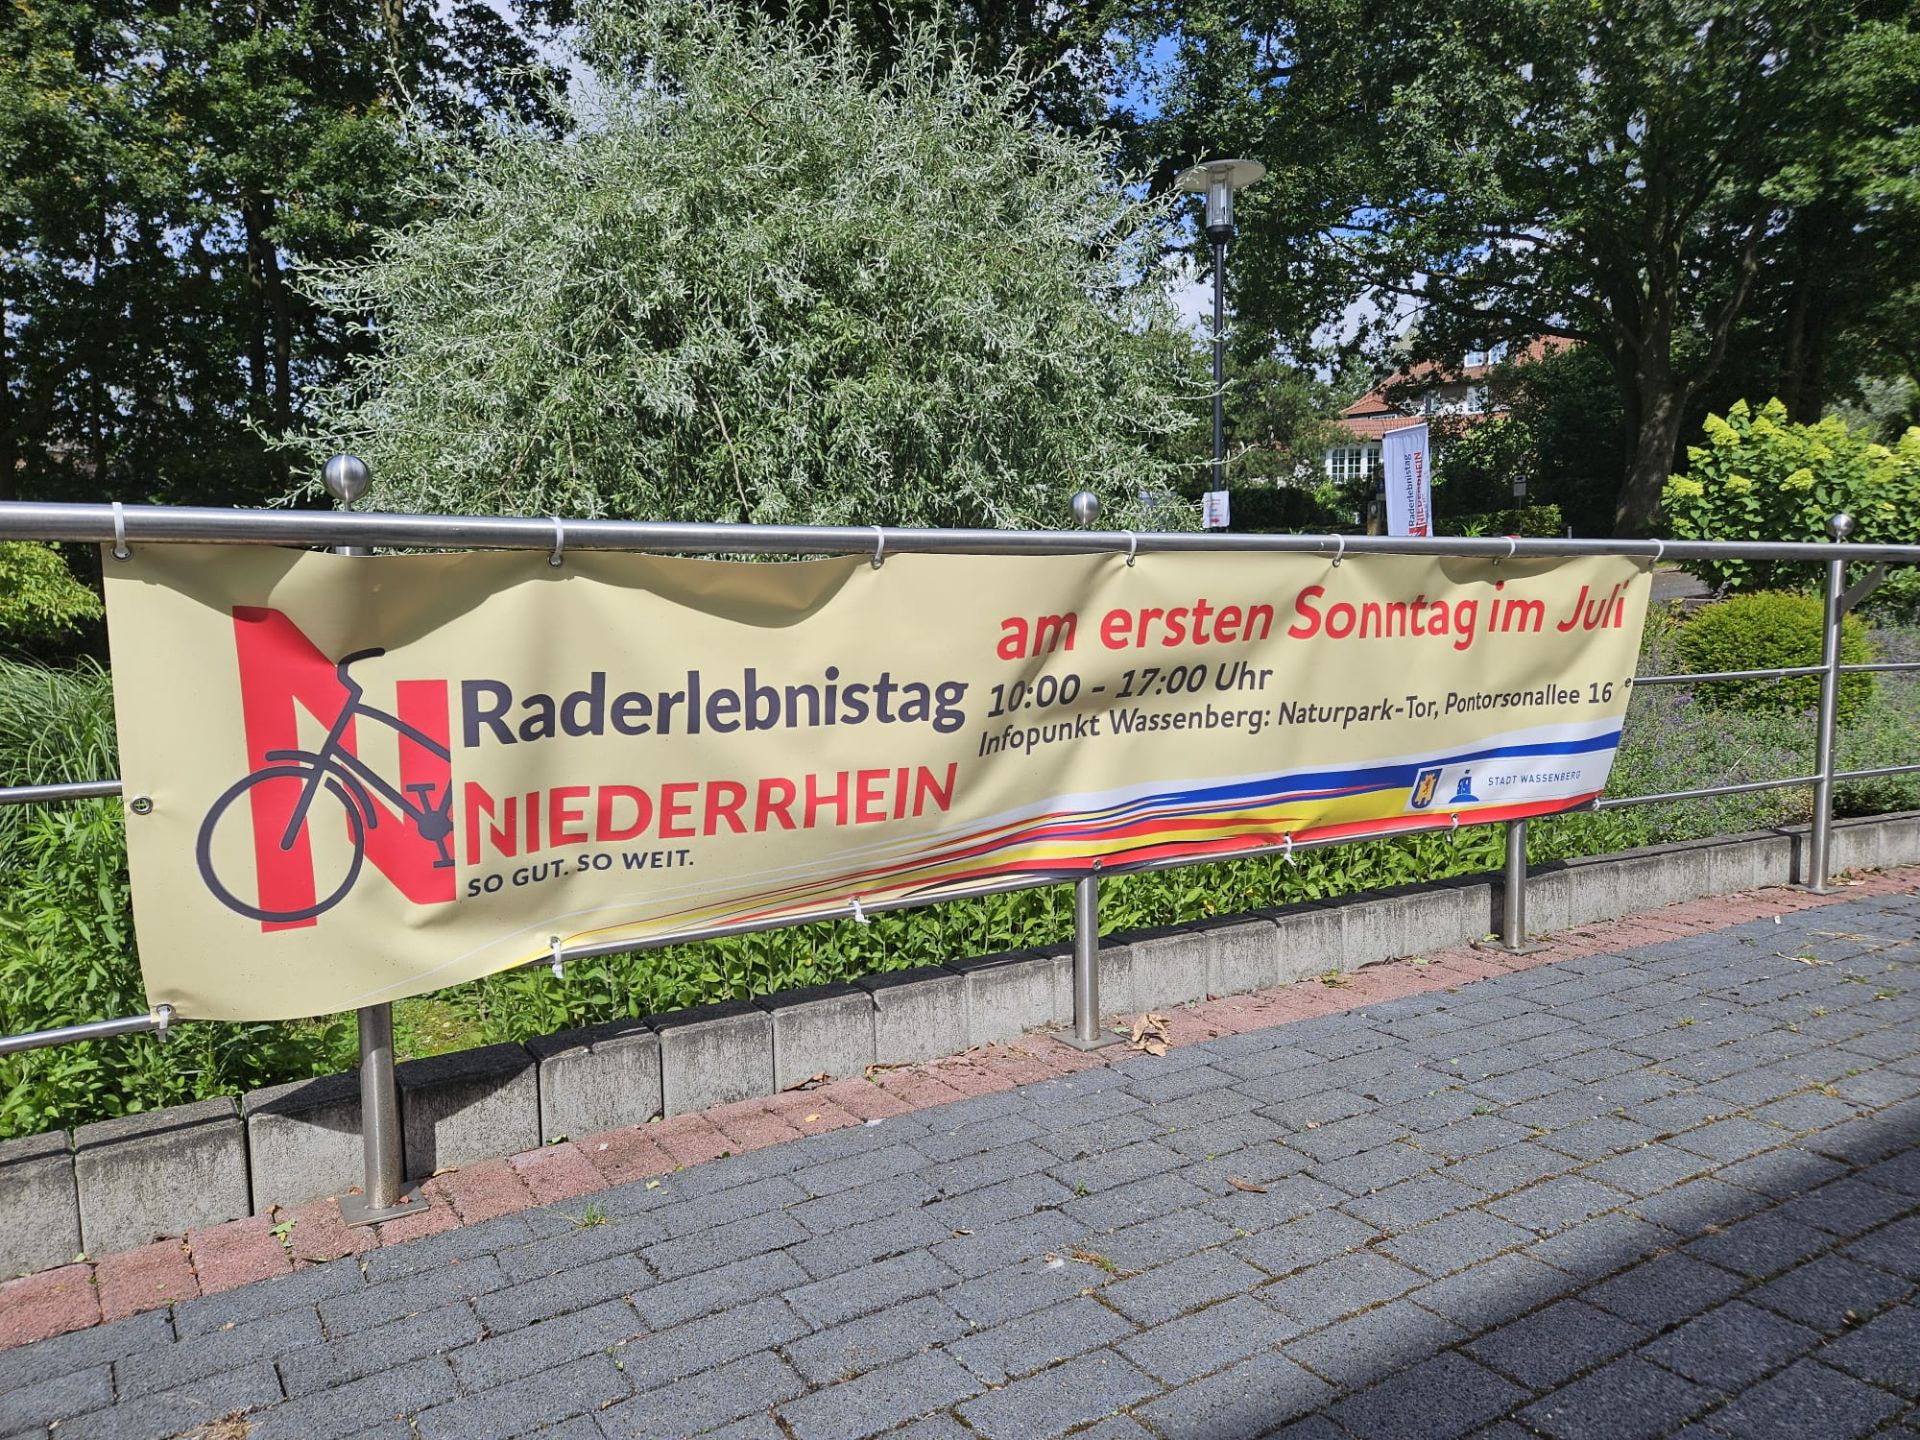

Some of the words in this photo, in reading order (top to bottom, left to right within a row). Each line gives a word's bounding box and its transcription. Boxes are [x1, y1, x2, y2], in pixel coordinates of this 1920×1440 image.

[1404, 454, 1415, 527] Raderlebnistag
[996, 611, 1078, 661] am
[1100, 598, 1274, 650] ersten
[1288, 585, 1478, 651] Sonntag
[1488, 580, 1546, 633] im
[1556, 579, 1630, 633] Juli
[461, 666, 969, 748] Raderlebnistag
[978, 714, 1100, 757] Infopunkt
[1109, 704, 1271, 734] Wassenberg:
[1278, 695, 1439, 730] Naturpark-Tor,
[1445, 683, 1580, 716] Pontorsonallee
[1587, 682, 1613, 704] 16
[987, 674, 1081, 718] 10:00
[1091, 685, 1105, 694] -
[1115, 664, 1208, 698] 17:00
[1214, 660, 1273, 691] Uhr
[464, 762, 958, 866] NIEDERRHEIN
[1488, 774, 1517, 786] STADT
[1520, 770, 1582, 785] WASSENBERG
[467, 873, 504, 898] SO
[512, 859, 571, 886] GUT.
[577, 852, 613, 872] SO
[622, 849, 695, 870] WEIT.
